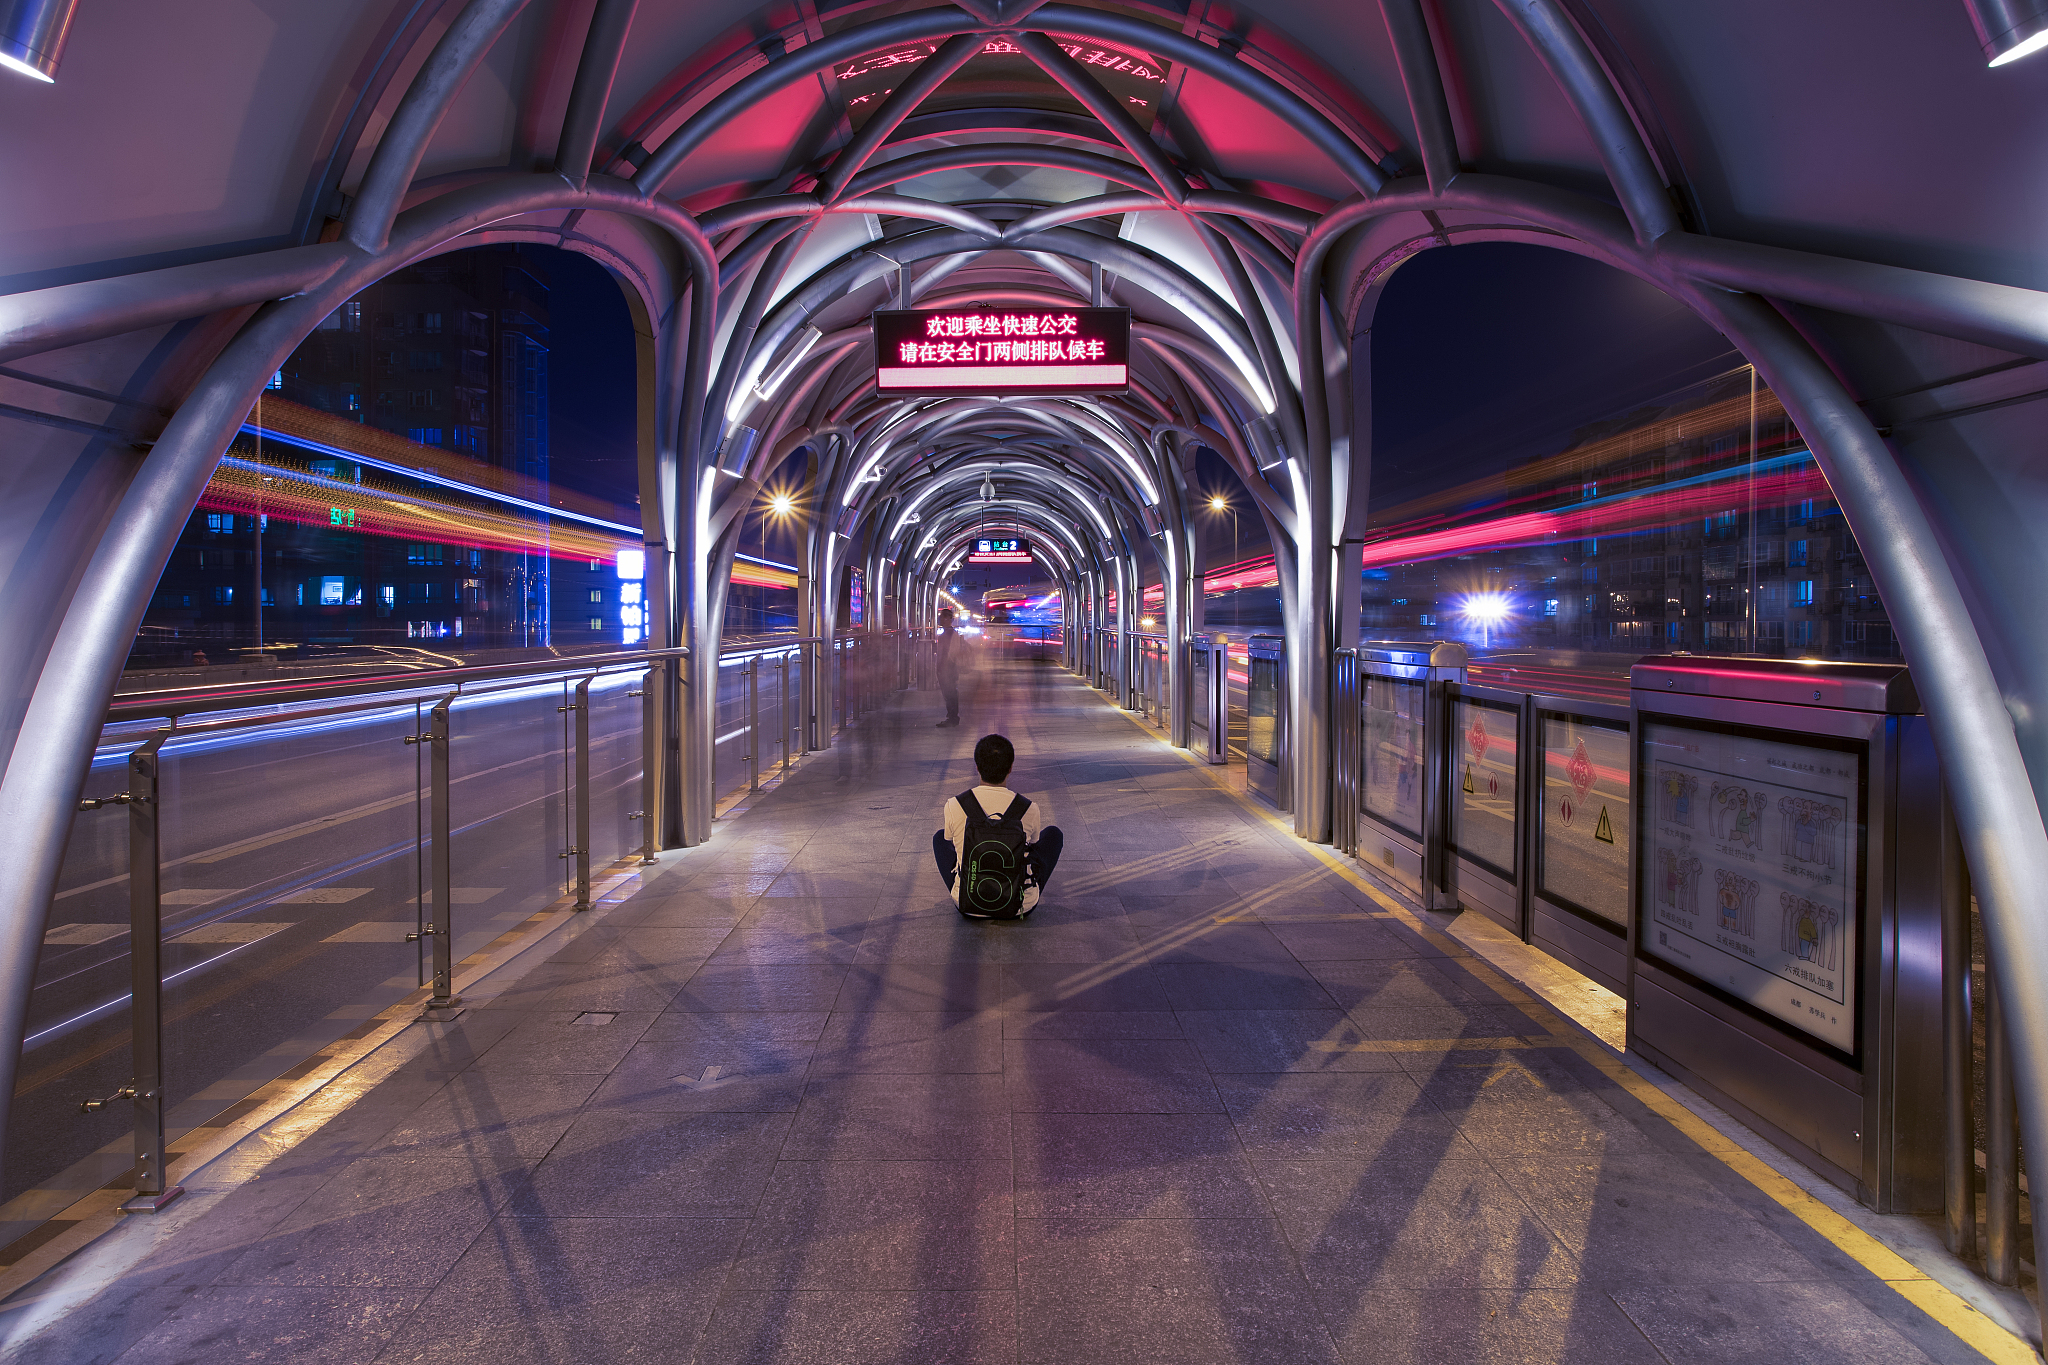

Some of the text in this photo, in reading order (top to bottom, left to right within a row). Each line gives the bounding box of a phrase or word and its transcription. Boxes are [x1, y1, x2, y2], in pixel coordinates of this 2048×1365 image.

[926, 314, 1078, 337] 欢迎乘坐快速公交
[899, 339, 1105, 363] 请在安全门两侧排队候车
[1009, 540, 1017, 550] 2
[1714, 843, 1756, 864] 二戒乱扔垃圾
[1781, 862, 1833, 886] 三戒不拘小节
[1715, 932, 1757, 959] 五戒袒胸露肚
[1784, 962, 1835, 992] 六戒排队加塞
